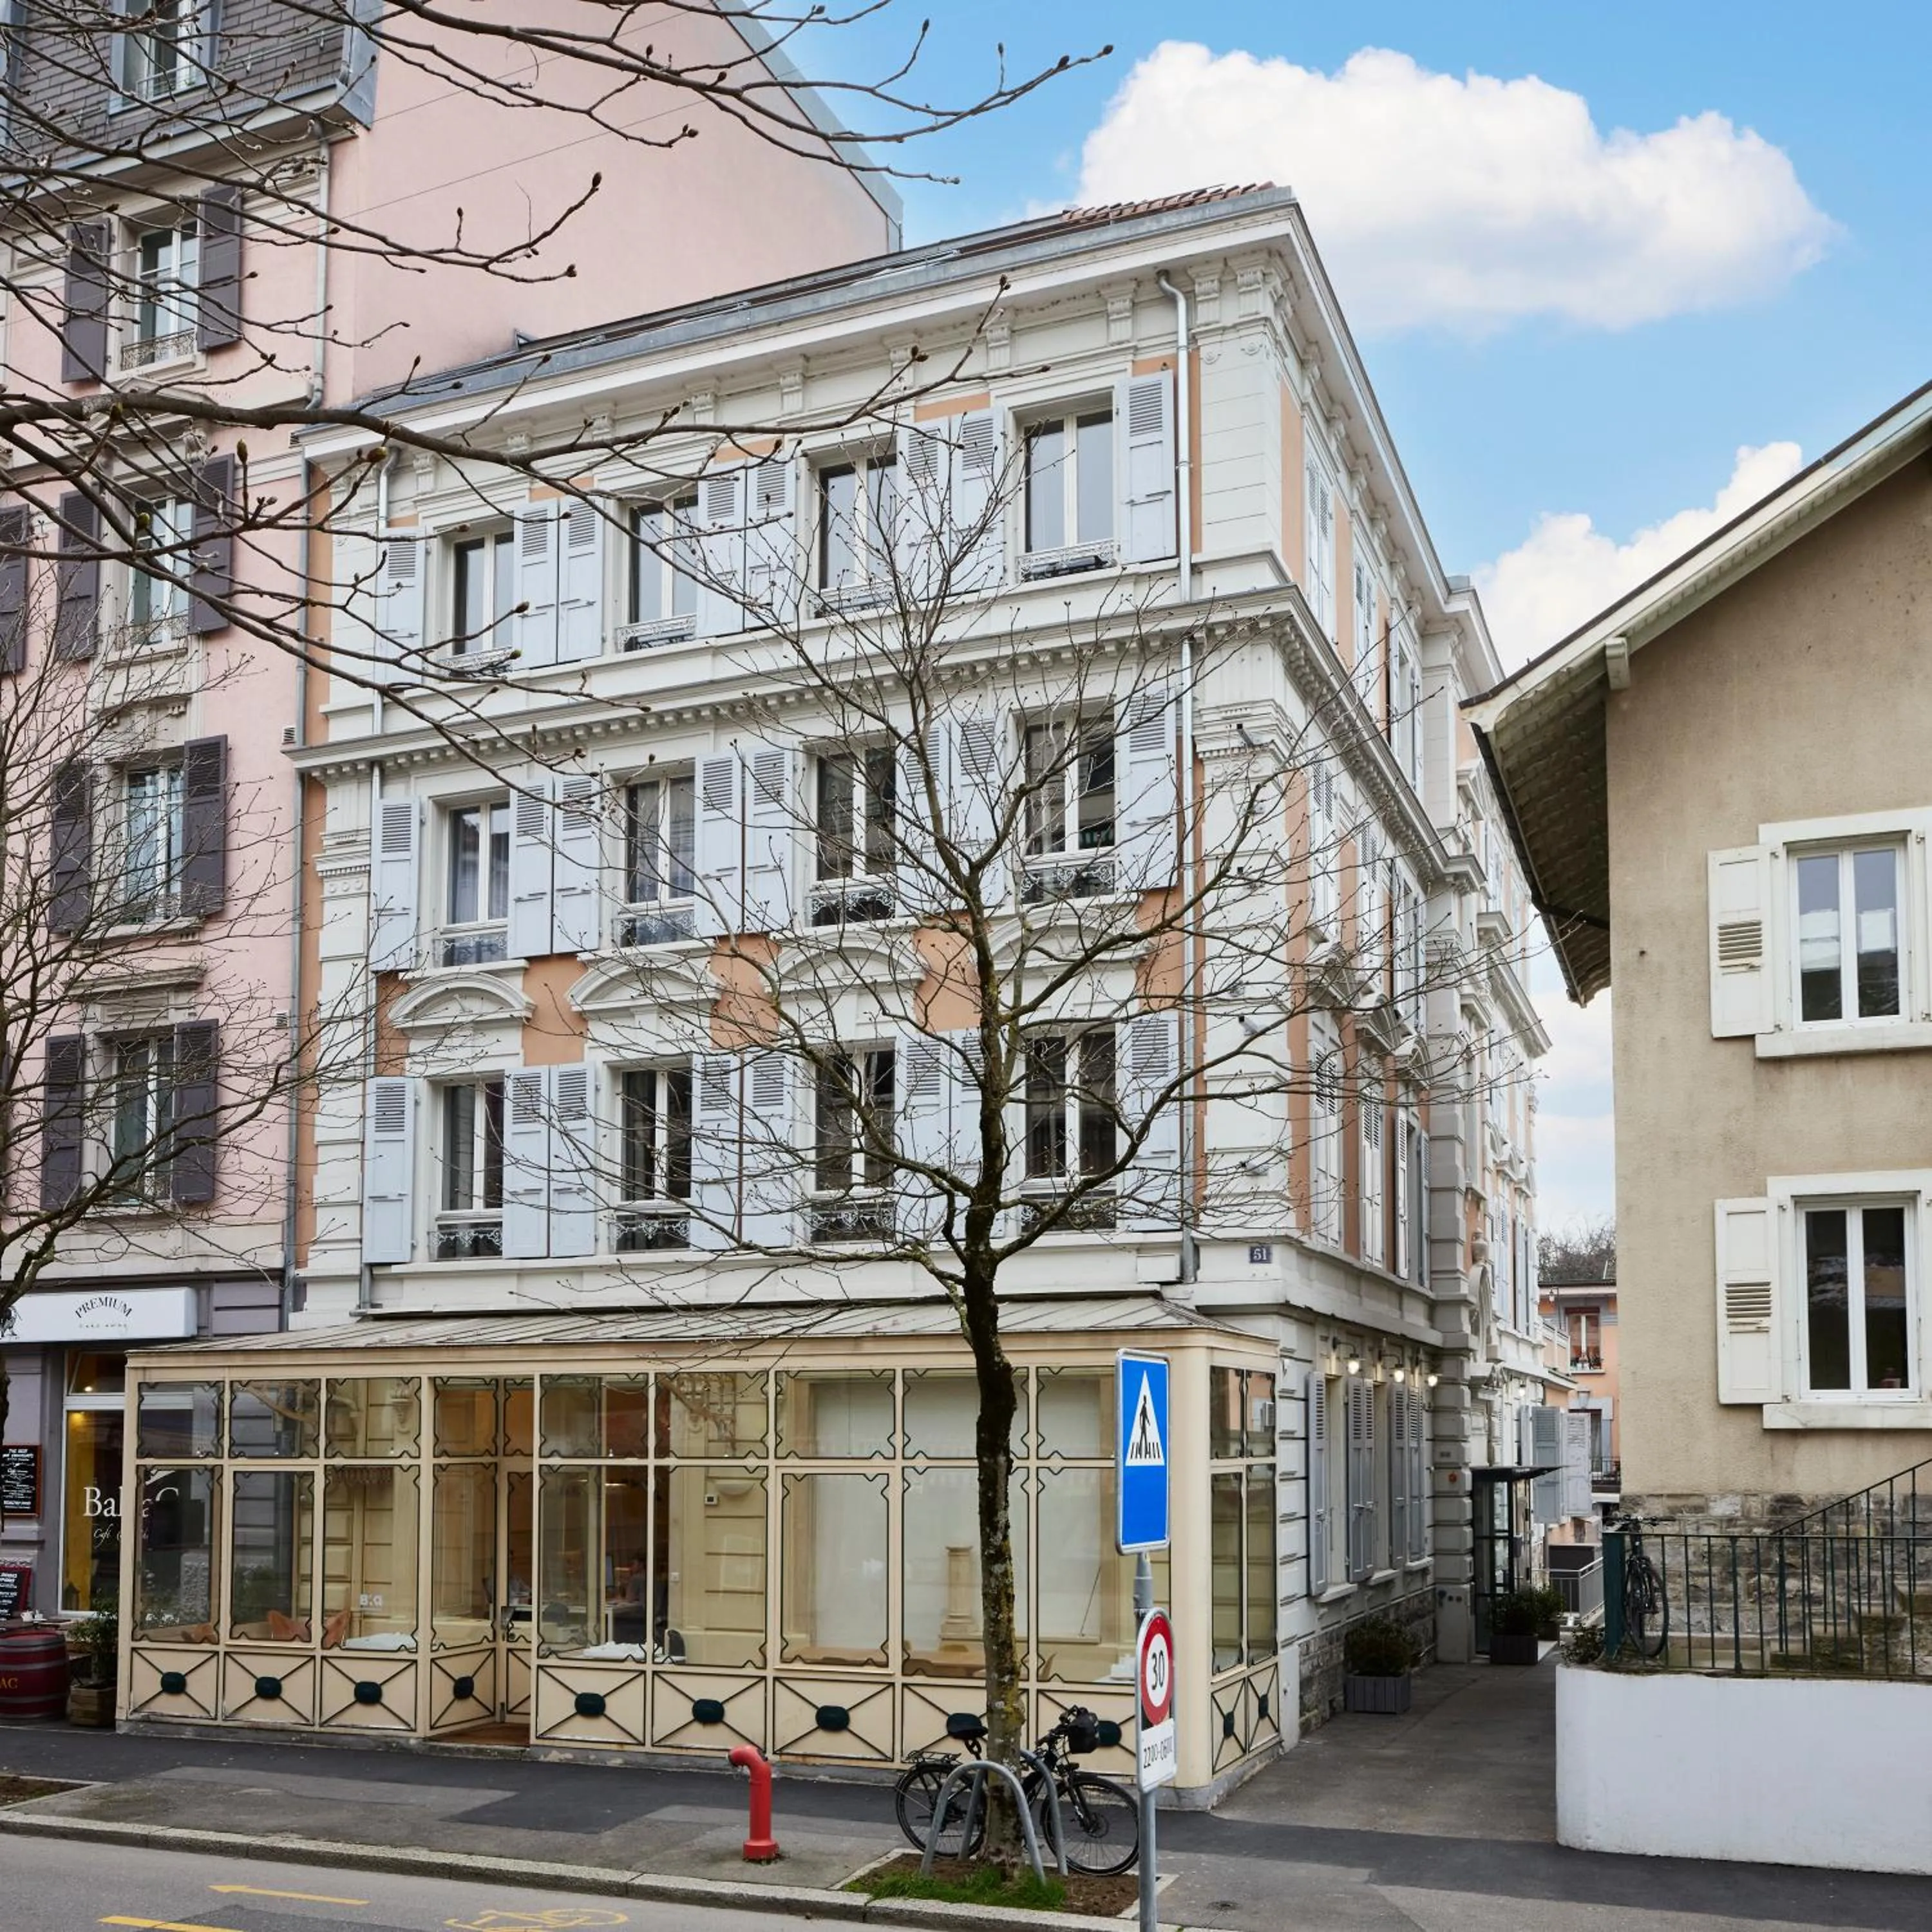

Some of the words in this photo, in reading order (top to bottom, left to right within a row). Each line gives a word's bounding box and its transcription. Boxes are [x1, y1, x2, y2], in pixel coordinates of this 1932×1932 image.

[1253, 1247, 1267, 1260] 51
[75, 1296, 133, 1318] PREMIUM
[1151, 1649, 1165, 1690] 30
